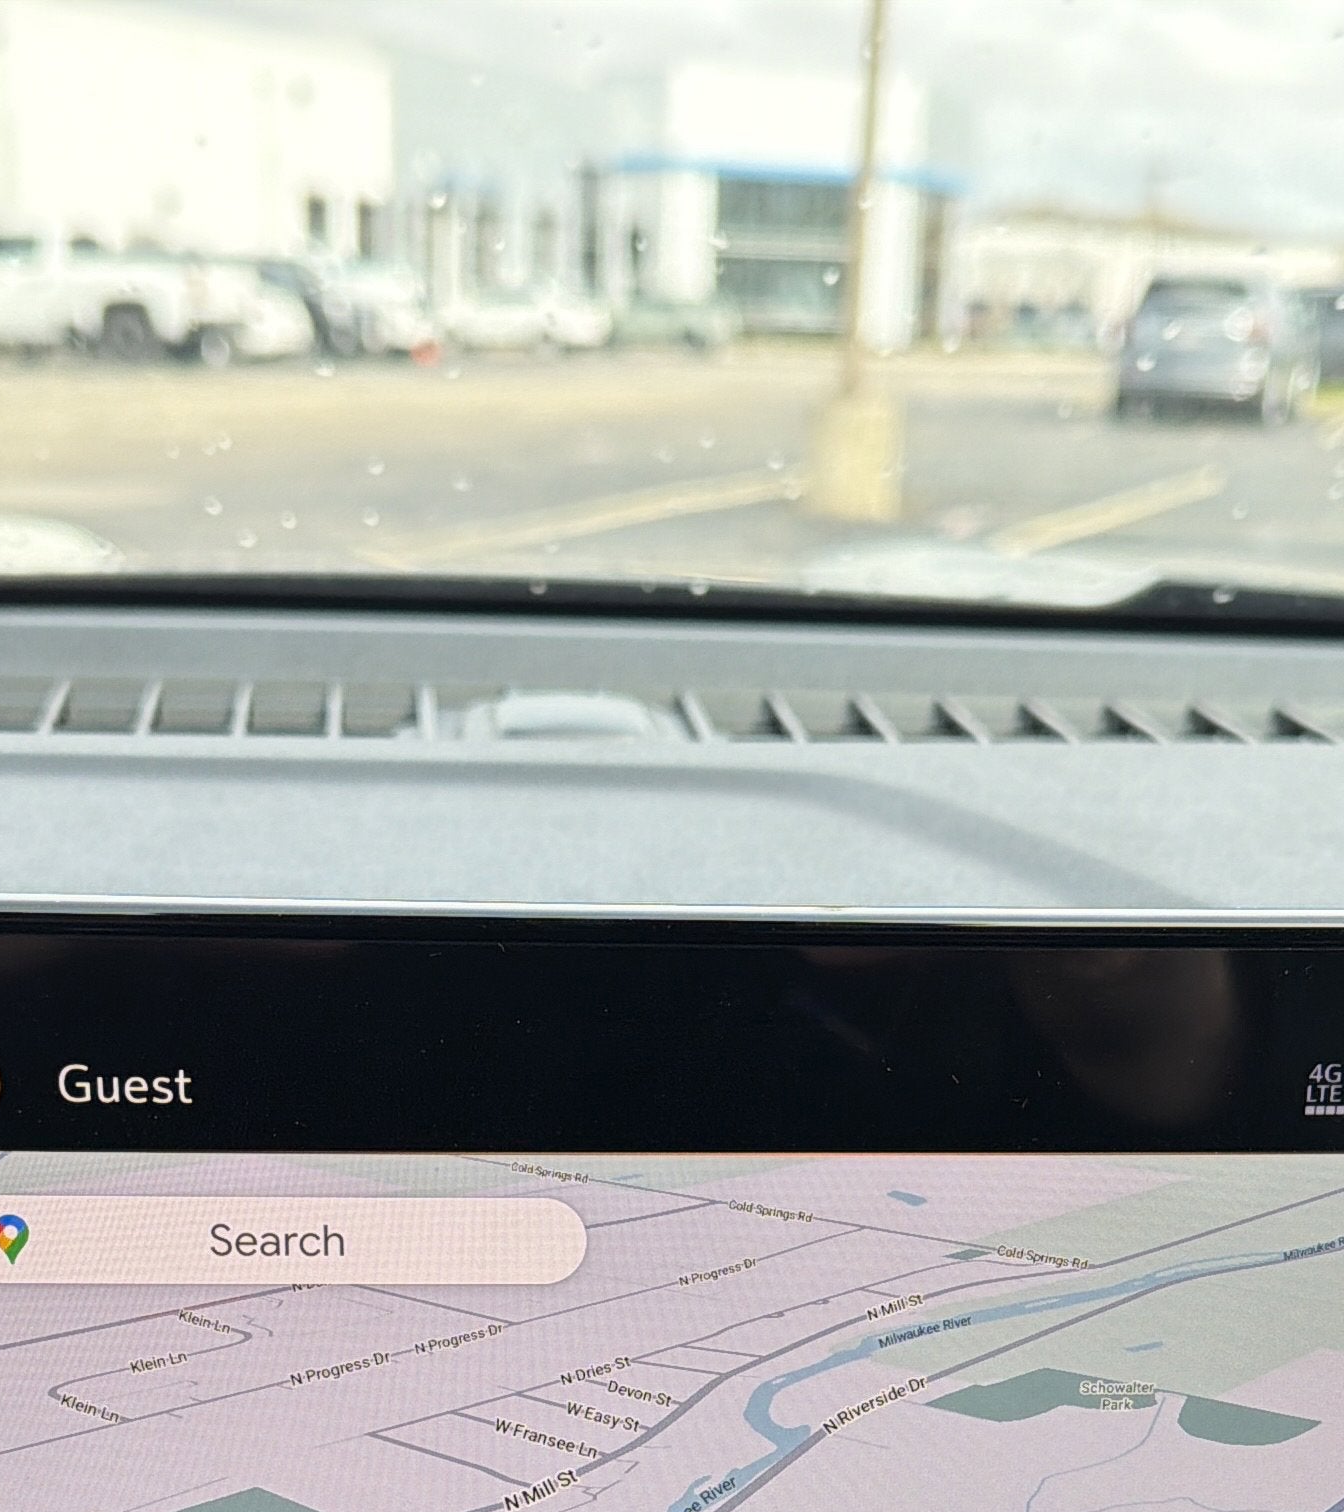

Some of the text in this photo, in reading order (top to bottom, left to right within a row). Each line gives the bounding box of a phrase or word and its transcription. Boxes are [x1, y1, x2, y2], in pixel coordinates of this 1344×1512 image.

[58, 1063, 193, 1106] Guest
[1308, 1064, 1343, 1083] 4G
[1306, 1084, 1343, 1104] LTE
[511, 1162, 590, 1184] Cold Springs Rd
[728, 1199, 813, 1223] Cold Springs Rd
[210, 1221, 346, 1259] Search
[1282, 1239, 1336, 1261] Milwaukee
[678, 1256, 757, 1286] N Progress Dr
[997, 1244, 1088, 1270] Cold Springs Rd
[178, 1309, 231, 1334] Klein Ln
[867, 1293, 923, 1321] N Mill St
[415, 1323, 504, 1355] N Progress Dr
[878, 1314, 972, 1349] Milwaukee River
[130, 1351, 187, 1374] Klein Ln
[290, 1351, 392, 1386] N Progress Dr
[560, 1355, 631, 1386] N Dries St
[607, 1380, 672, 1408] Devon St
[1080, 1381, 1154, 1395] Schowalter
[60, 1394, 120, 1424] Klein Ln
[566, 1402, 640, 1433] W Easy St
[823, 1376, 928, 1435] N Riverside Dr
[1102, 1398, 1132, 1412] Park
[494, 1418, 598, 1459] W Fransee Ln
[503, 1469, 579, 1512] N Mill St
[699, 1475, 737, 1508] River
